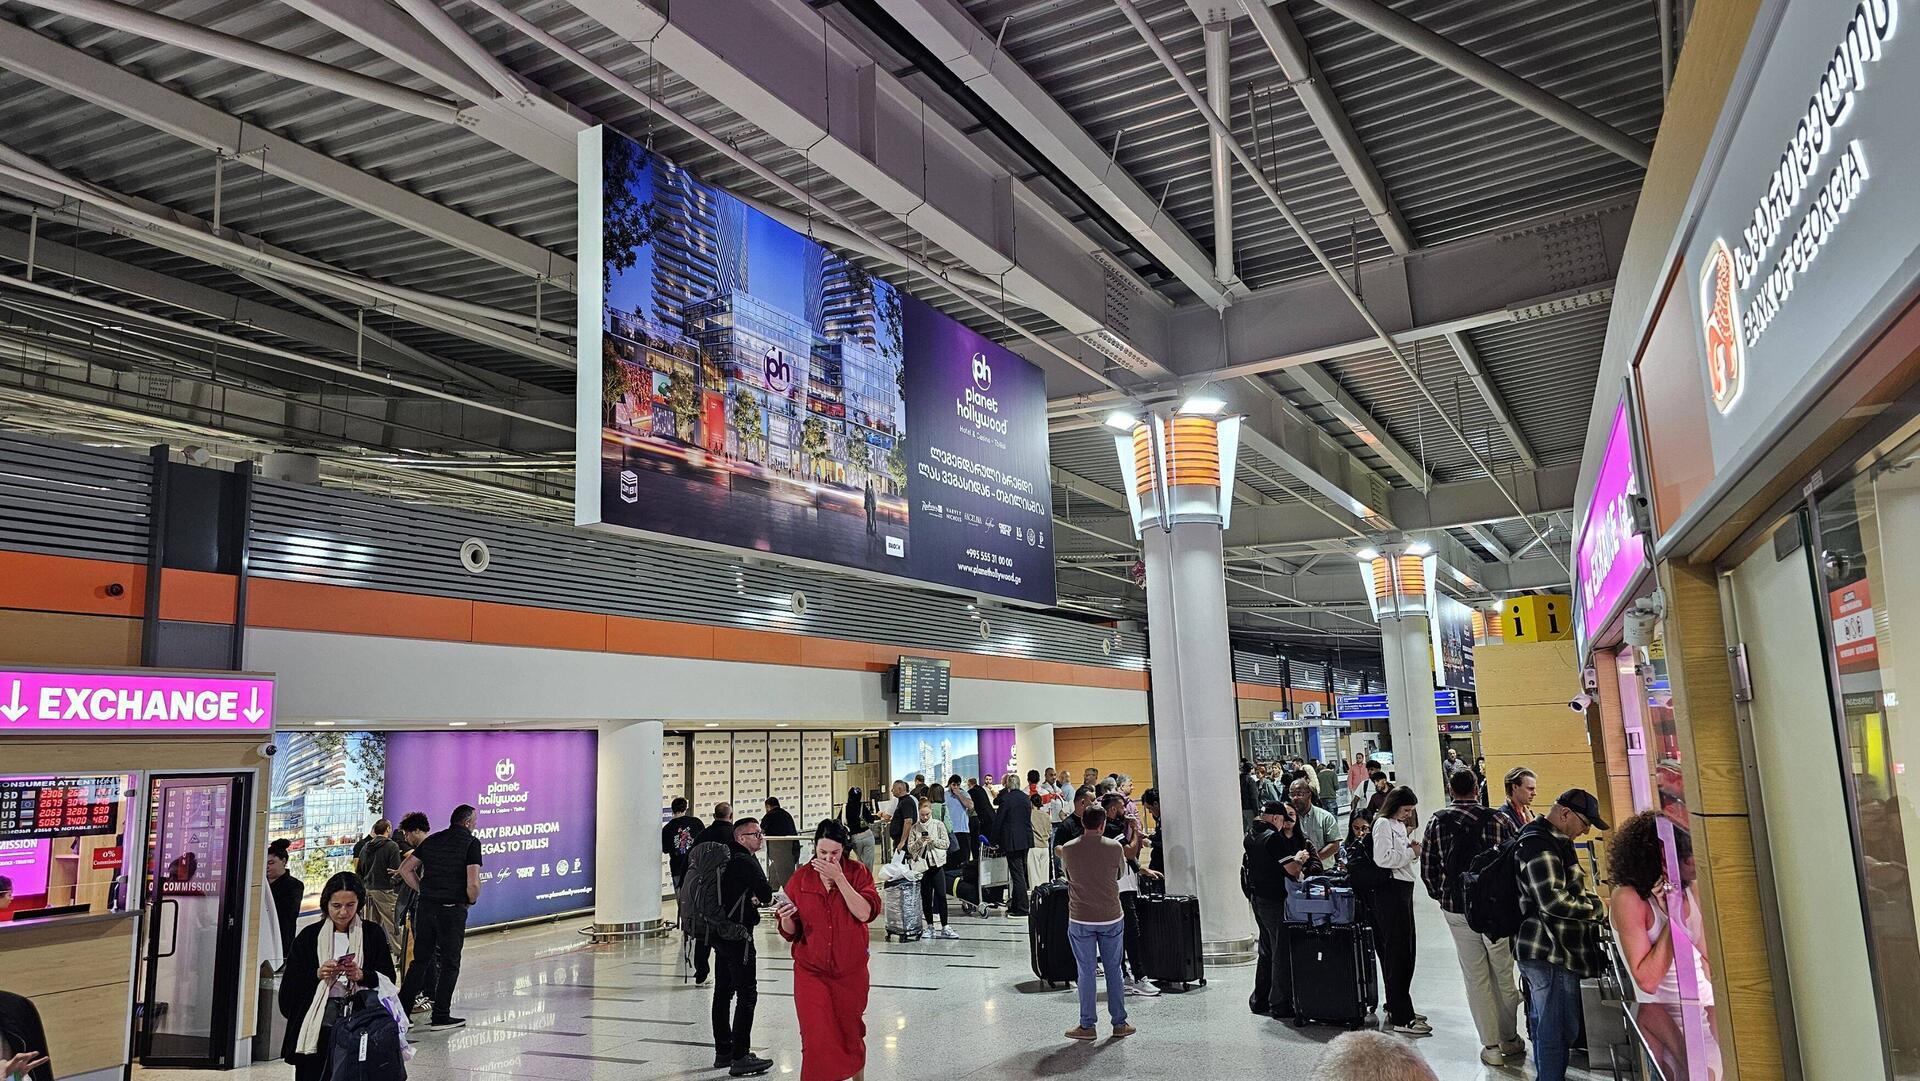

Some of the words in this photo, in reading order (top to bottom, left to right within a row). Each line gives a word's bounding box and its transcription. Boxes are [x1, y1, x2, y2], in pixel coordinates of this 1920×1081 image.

[1743, 275, 1779, 347] BANK
[1773, 246, 1794, 301] OF
[1792, 139, 1870, 273] GEORGIA
[965, 387, 998, 413] planet
[957, 398, 1008, 435] hollywood
[980, 551, 991, 562] 555
[38, 687, 239, 721] EXCHANGE
[496, 758, 515, 781] ph
[0, 791, 18, 799] SD
[487, 782, 520, 795] planet
[478, 792, 528, 807] hollywood
[499, 823, 533, 838] BRAND
[533, 821, 560, 834] FROM
[506, 840, 520, 852] TO
[521, 838, 549, 850] TBILISI
[163, 882, 217, 892] COMMISSION
